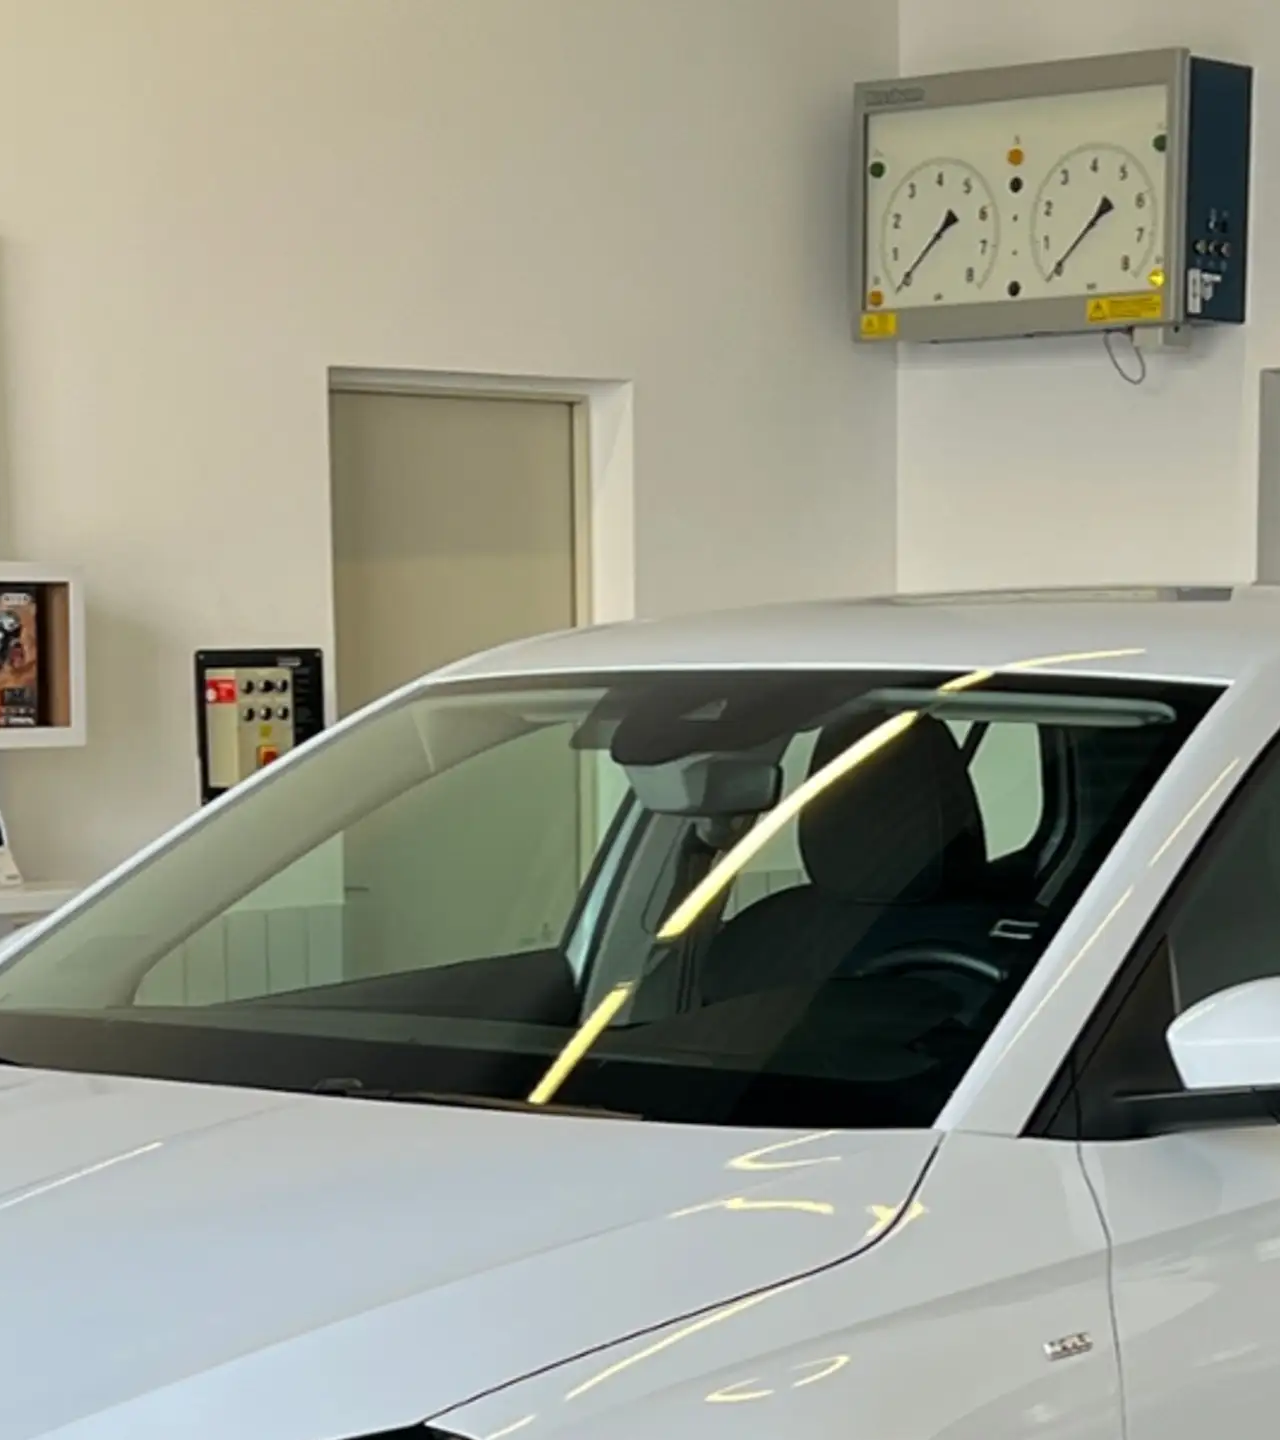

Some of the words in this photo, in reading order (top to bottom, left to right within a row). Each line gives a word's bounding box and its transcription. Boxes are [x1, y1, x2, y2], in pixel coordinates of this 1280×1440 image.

[1090, 157, 1098, 173] 4
[1120, 164, 1128, 181] 5
[936, 172, 944, 187] 4
[1061, 169, 1069, 185] 3
[908, 182, 916, 199] 3
[963, 178, 972, 194] 5
[1045, 200, 1053, 216] 2
[1135, 192, 1145, 208] 6
[892, 213, 902, 229] 2
[978, 205, 988, 221] 6
[1044, 235, 1050, 250] 1
[1136, 227, 1144, 243] 7
[892, 247, 898, 261] 1
[980, 239, 987, 255] 7
[1121, 255, 1130, 271] 8
[965, 267, 974, 283] 8
